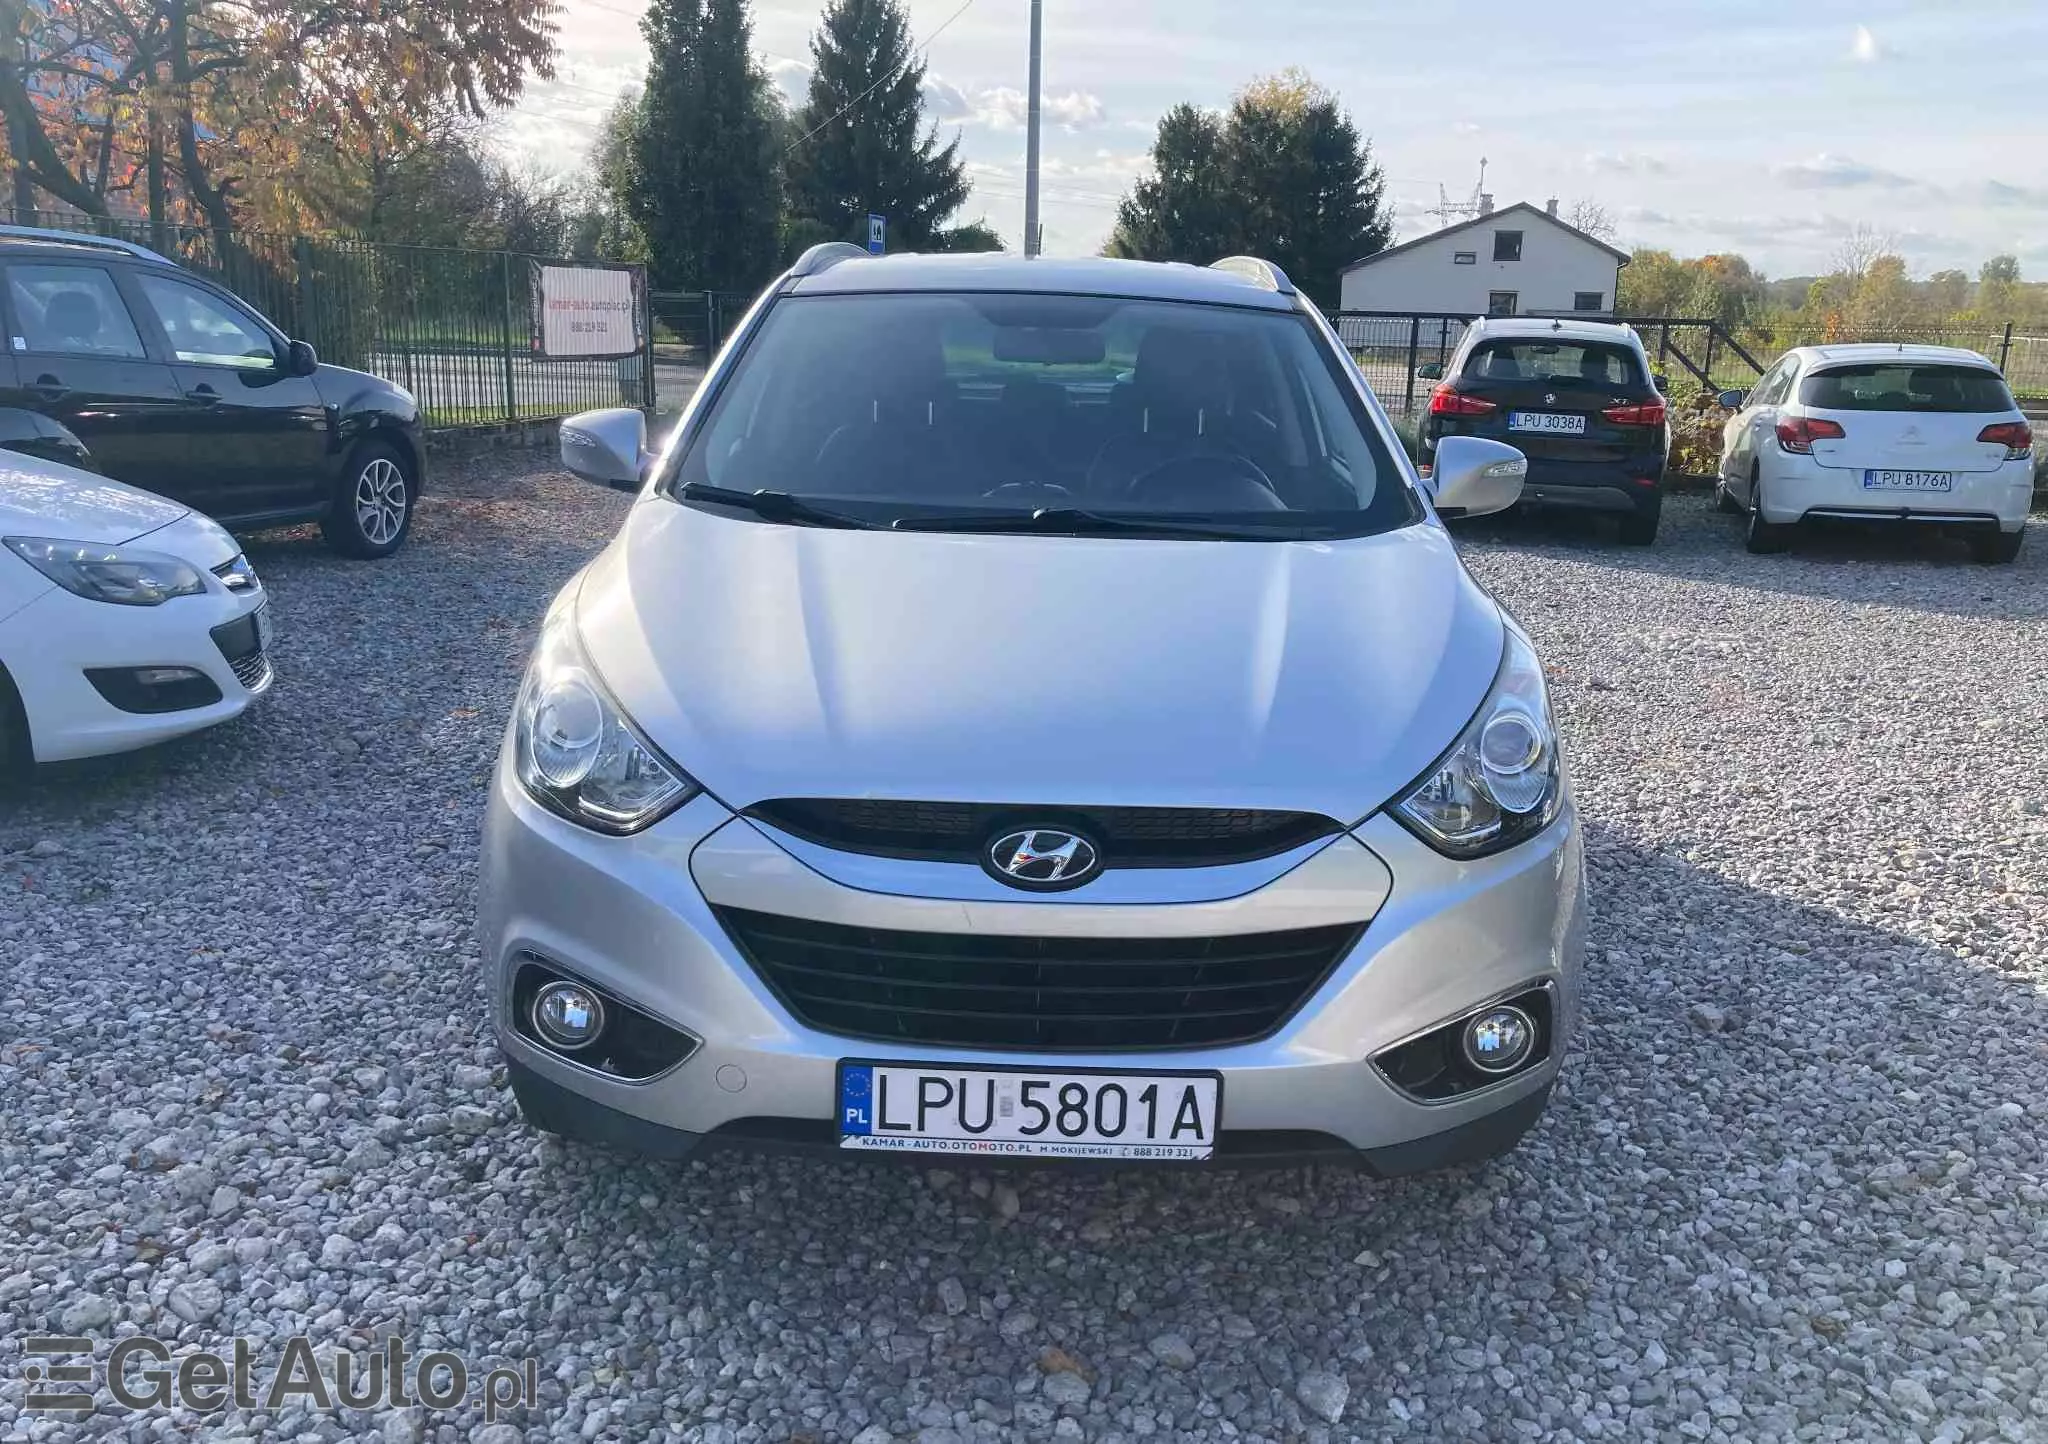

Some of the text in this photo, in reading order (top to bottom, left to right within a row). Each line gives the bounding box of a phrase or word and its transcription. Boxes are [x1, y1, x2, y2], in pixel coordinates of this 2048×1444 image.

[1517, 414, 1583, 430] LPU 3038A
[1874, 471, 1948, 487] LPU 8176A
[879, 1074, 1204, 1140] LPU 5801A
[846, 1108, 868, 1124] PL
[1134, 1147, 1152, 1157] 888
[1155, 1148, 1173, 1157] 219
[1176, 1148, 1193, 1157] 321
